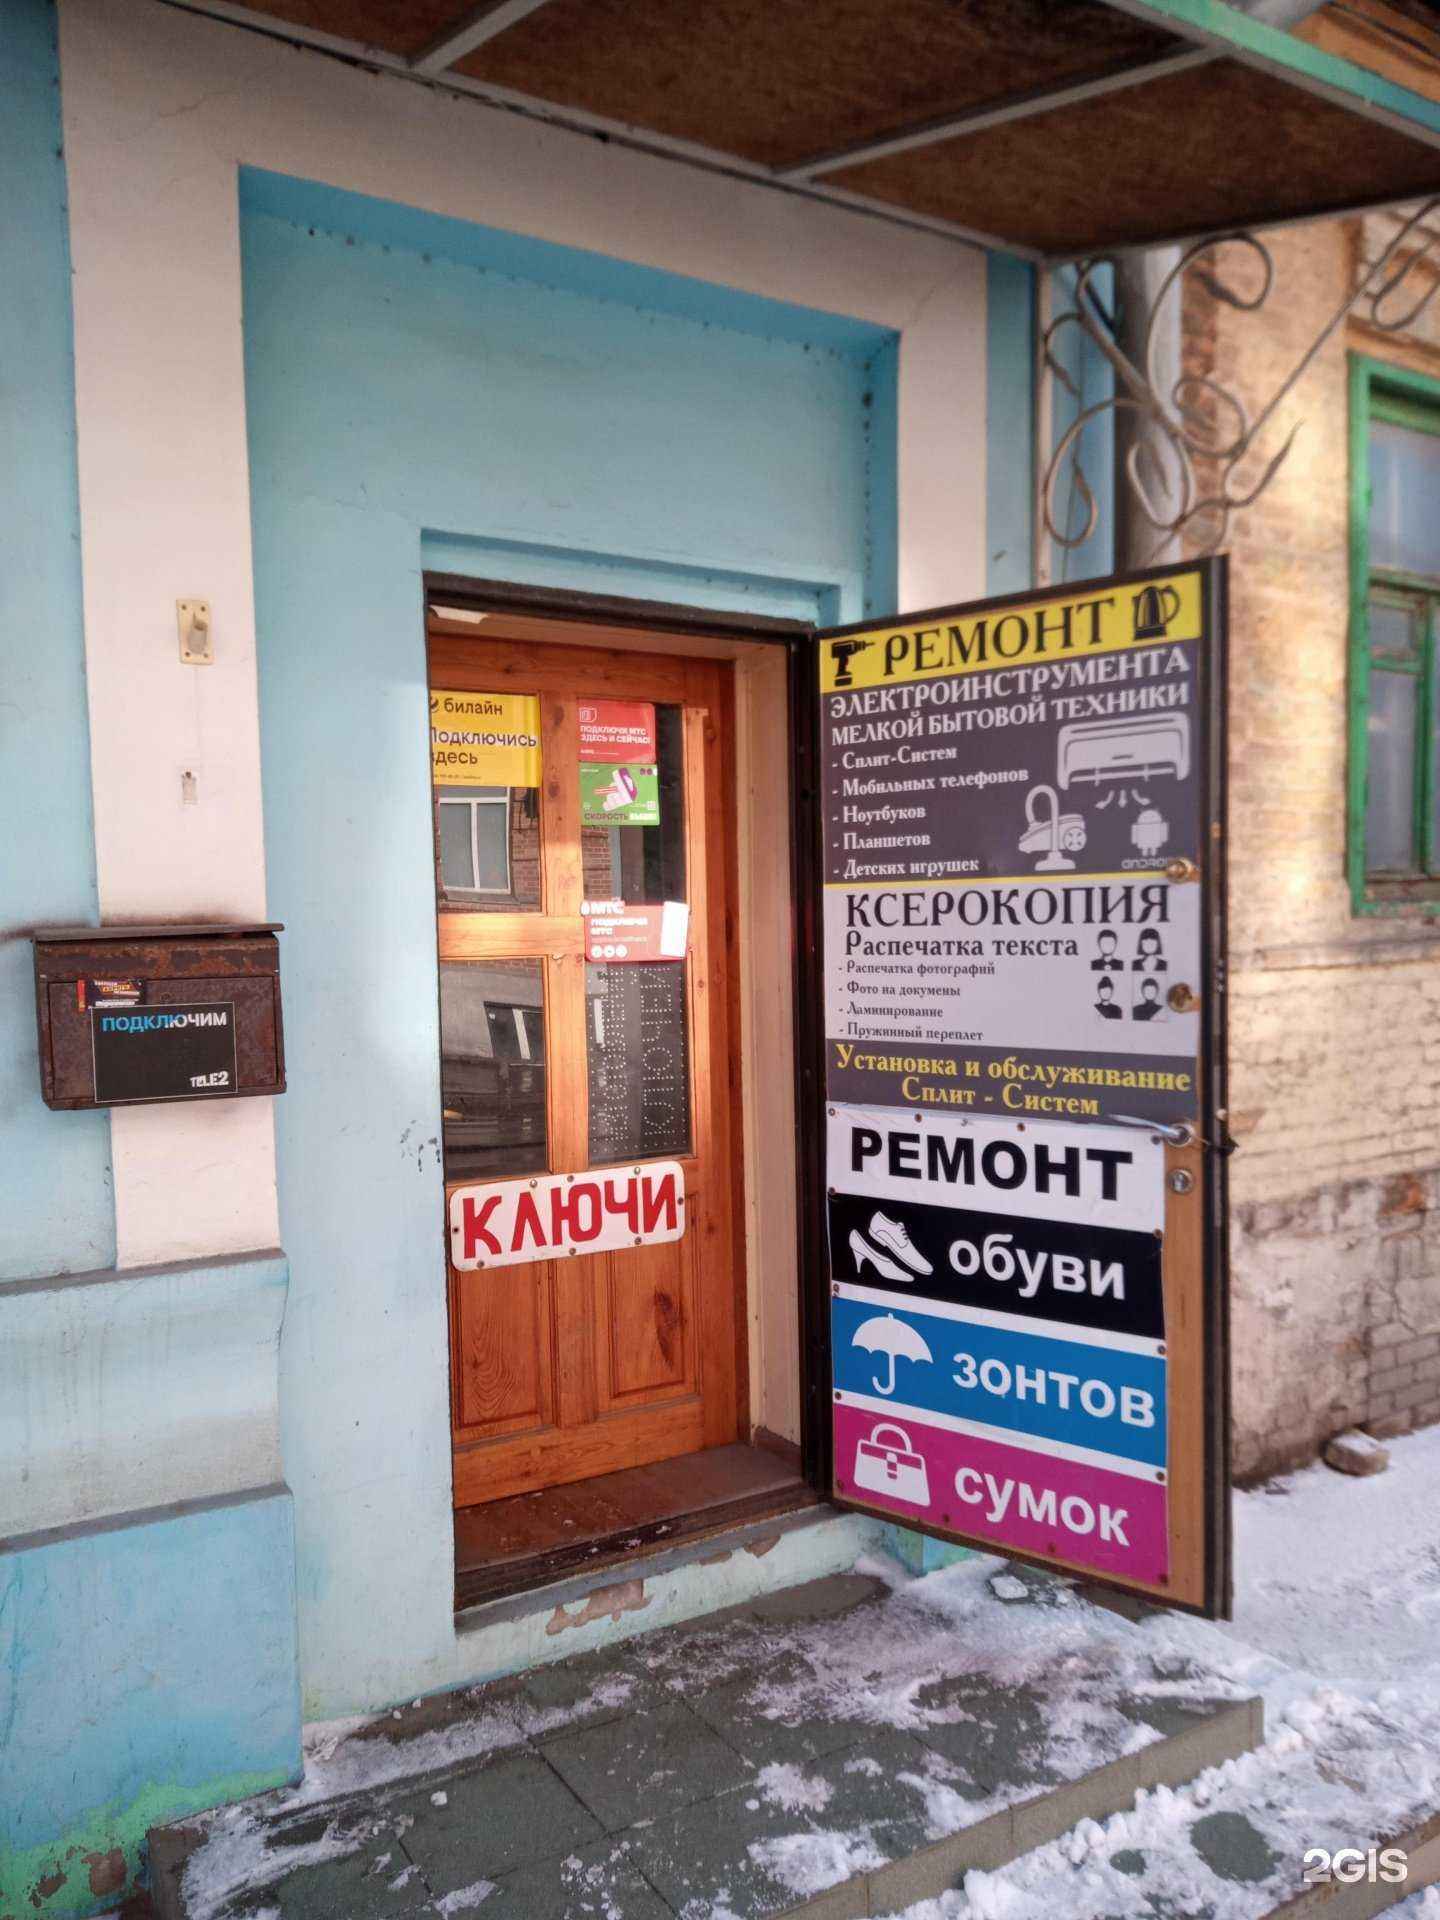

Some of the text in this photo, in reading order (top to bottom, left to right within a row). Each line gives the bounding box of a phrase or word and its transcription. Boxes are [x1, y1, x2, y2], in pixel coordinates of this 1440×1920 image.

[882, 597, 1115, 676] РЕМОНТ
[830, 646, 1190, 719] ЭЛЕКТРОИНСТРУМЕНТА
[444, 697, 503, 716] билайн
[832, 681, 1190, 746] МЕЛКОЙ БЫТОВОЙ ТЕХНИКИ
[842, 746, 957, 769] Сплит-Систем
[842, 768, 1030, 797] Мобильных телефонов
[842, 805, 926, 826] Ноутбуков
[842, 832, 931, 850] Планшетов
[843, 859, 979, 879] Детских игрушек
[845, 884, 1171, 928] КСЕРОКОПИЯ
[845, 929, 1079, 957] Распечатка текста
[846, 960, 996, 978] Распечатка фотографий
[846, 980, 961, 998] Фото на докумены
[101, 1011, 227, 1034] ПОДКЛЮЧИМ
[846, 1001, 944, 1019] Ламинирование
[847, 1021, 984, 1042] Пружинный переплет
[189, 1071, 230, 1088] TELE2
[835, 1043, 1191, 1092] Установка и обслуживание
[901, 1076, 976, 1105] Сплит
[1001, 1083, 1100, 1116] Систем
[850, 1126, 1133, 1201] РЕМОНТ
[462, 1173, 677, 1259] КЛЮЧИ
[948, 1233, 1126, 1300] обуви
[951, 1352, 1156, 1428] зонтов
[953, 1466, 1130, 1547] сумок
